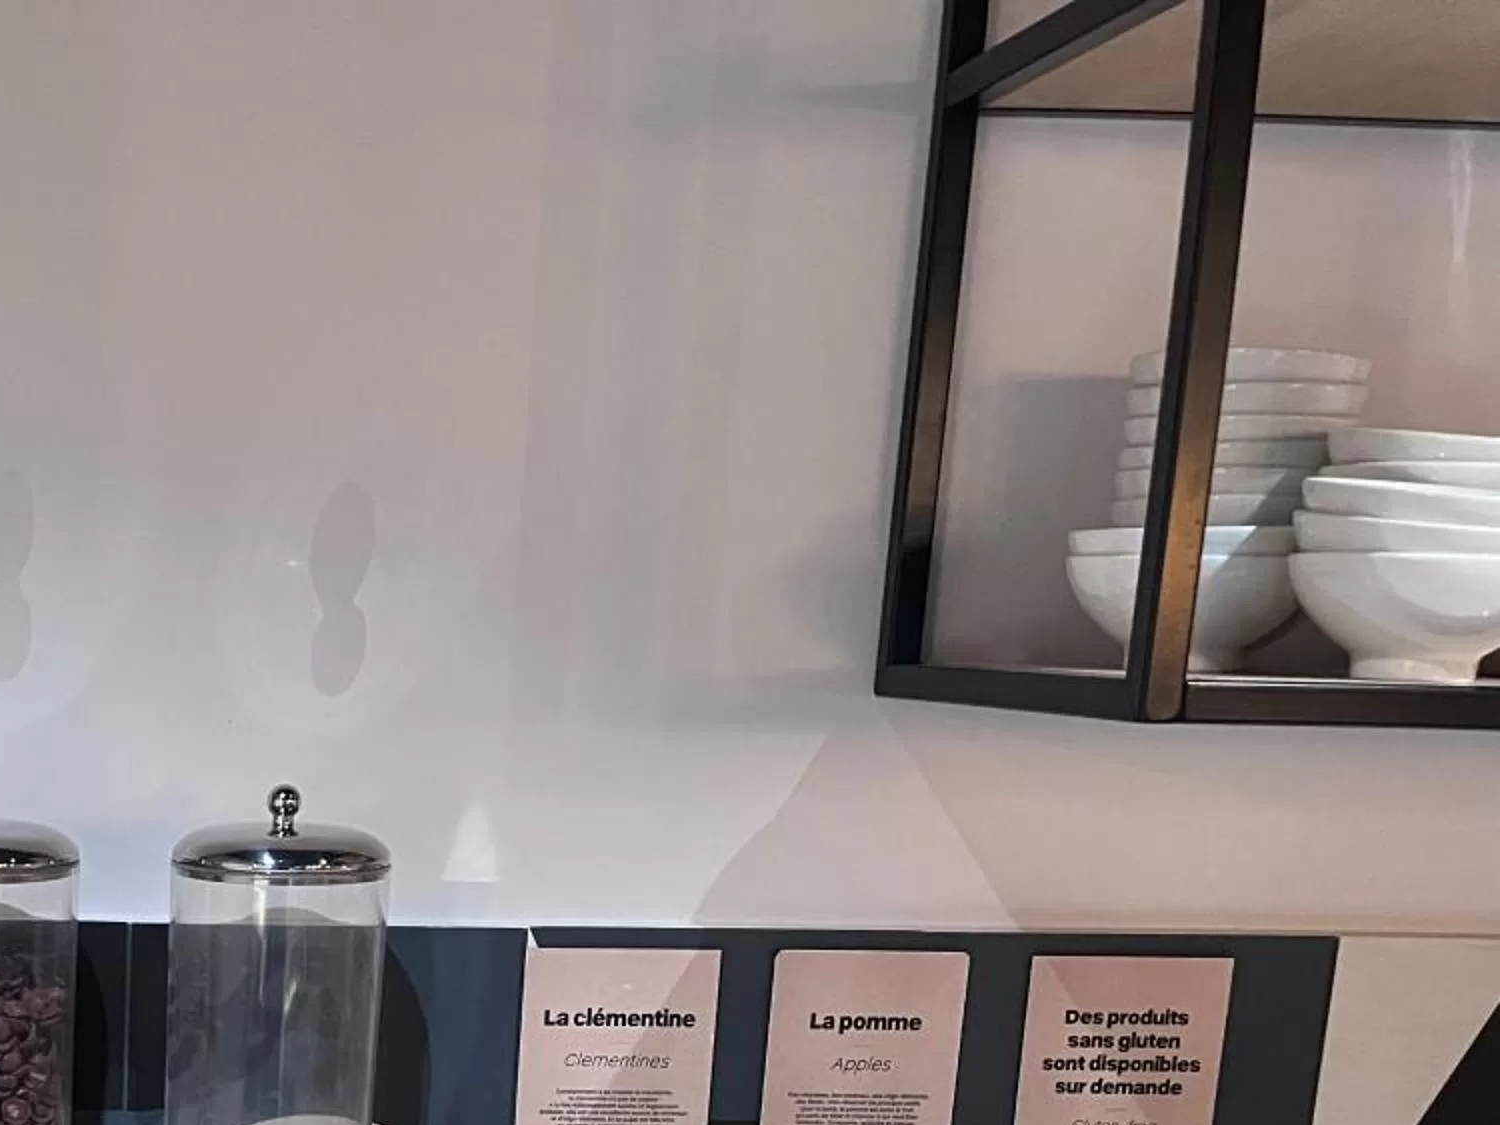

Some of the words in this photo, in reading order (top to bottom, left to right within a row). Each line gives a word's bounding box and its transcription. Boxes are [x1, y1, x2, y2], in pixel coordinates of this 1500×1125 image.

[543, 1008, 569, 1027] La
[573, 1007, 696, 1028] clémentine
[809, 1012, 835, 1030] La
[839, 1014, 923, 1035] pomme
[1065, 1009, 1104, 1025] Des
[1107, 1008, 1189, 1029] produits
[1067, 1035, 1114, 1049] sans
[1118, 1032, 1181, 1053] gluten
[563, 1052, 672, 1069] Clementines
[830, 1056, 893, 1075] Apples
[1042, 1056, 1086, 1071] sont
[1090, 1054, 1201, 1075] disponibles
[1055, 1081, 1086, 1095] sur
[1090, 1077, 1183, 1096] demande
